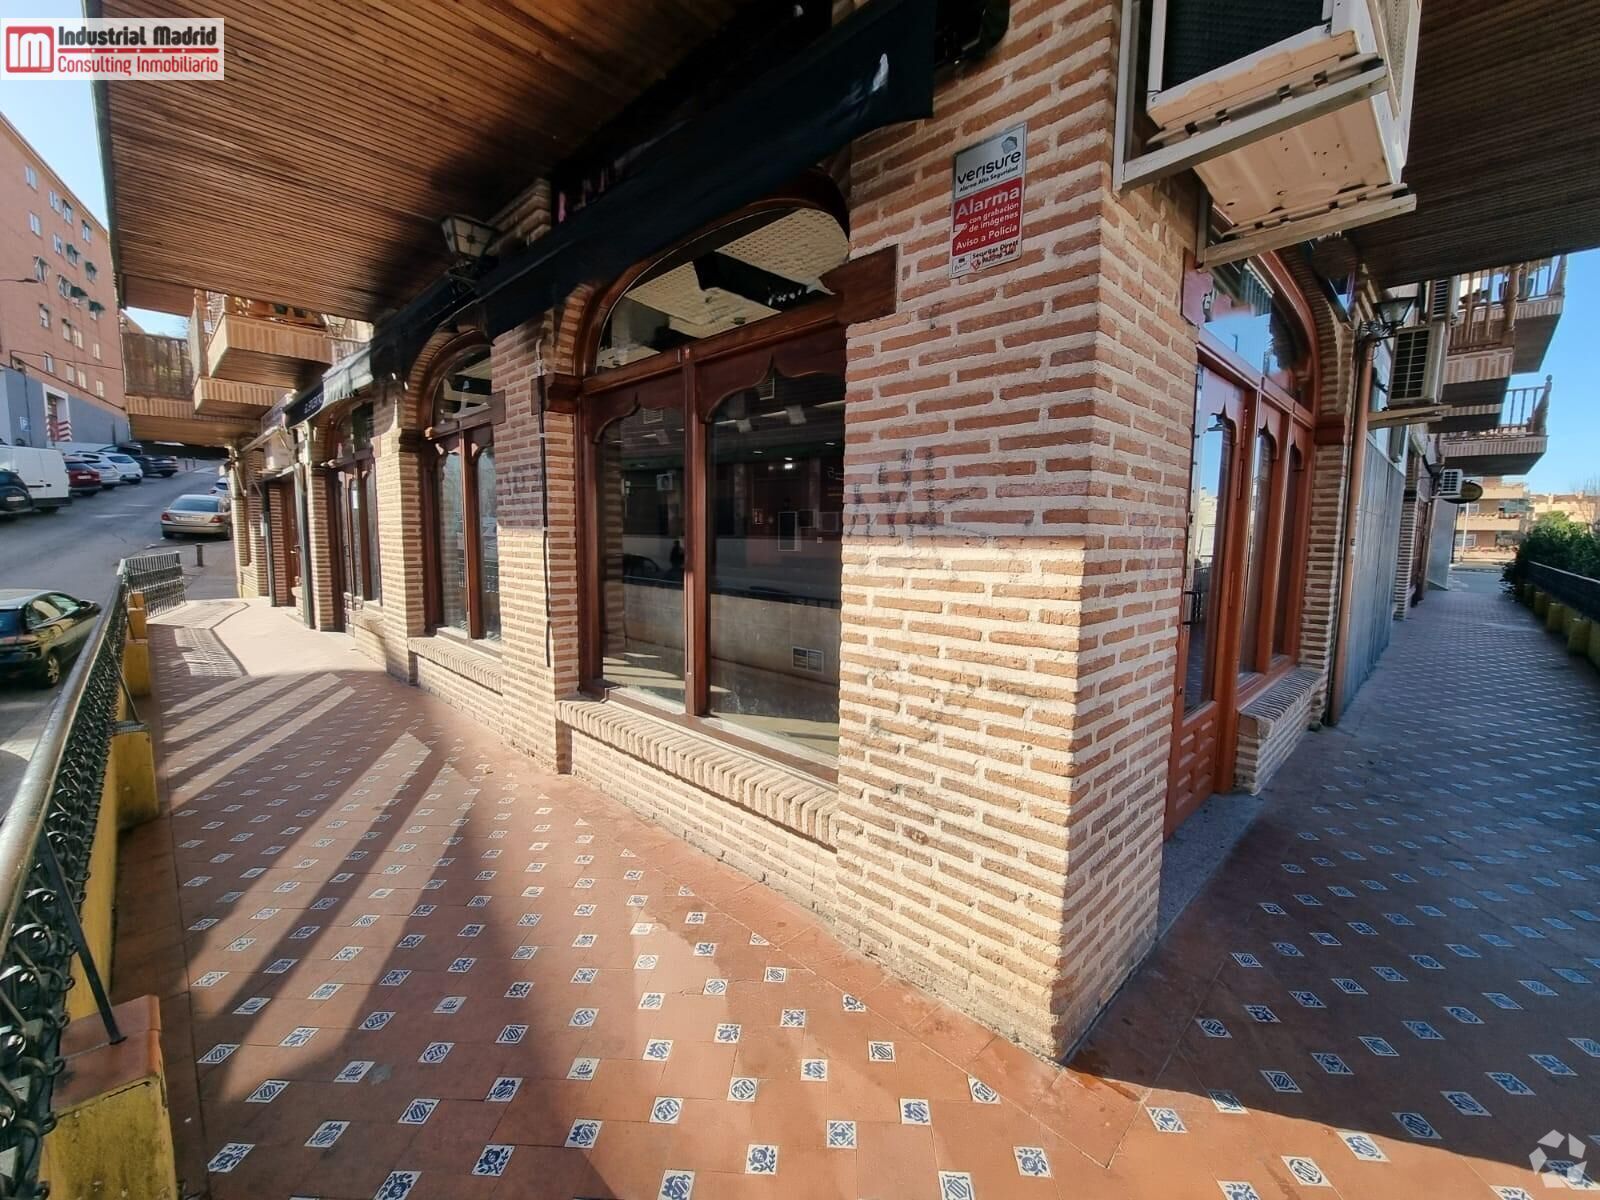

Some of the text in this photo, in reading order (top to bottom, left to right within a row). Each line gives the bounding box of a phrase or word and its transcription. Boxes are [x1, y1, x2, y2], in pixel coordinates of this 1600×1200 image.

[957, 151, 1021, 184] verisure
[990, 165, 1018, 180] Seguridad
[956, 187, 1020, 219] Alarma
[969, 202, 1019, 224] con grabación
[969, 211, 1019, 233] de imágenes
[956, 237, 978, 250] Aviso
